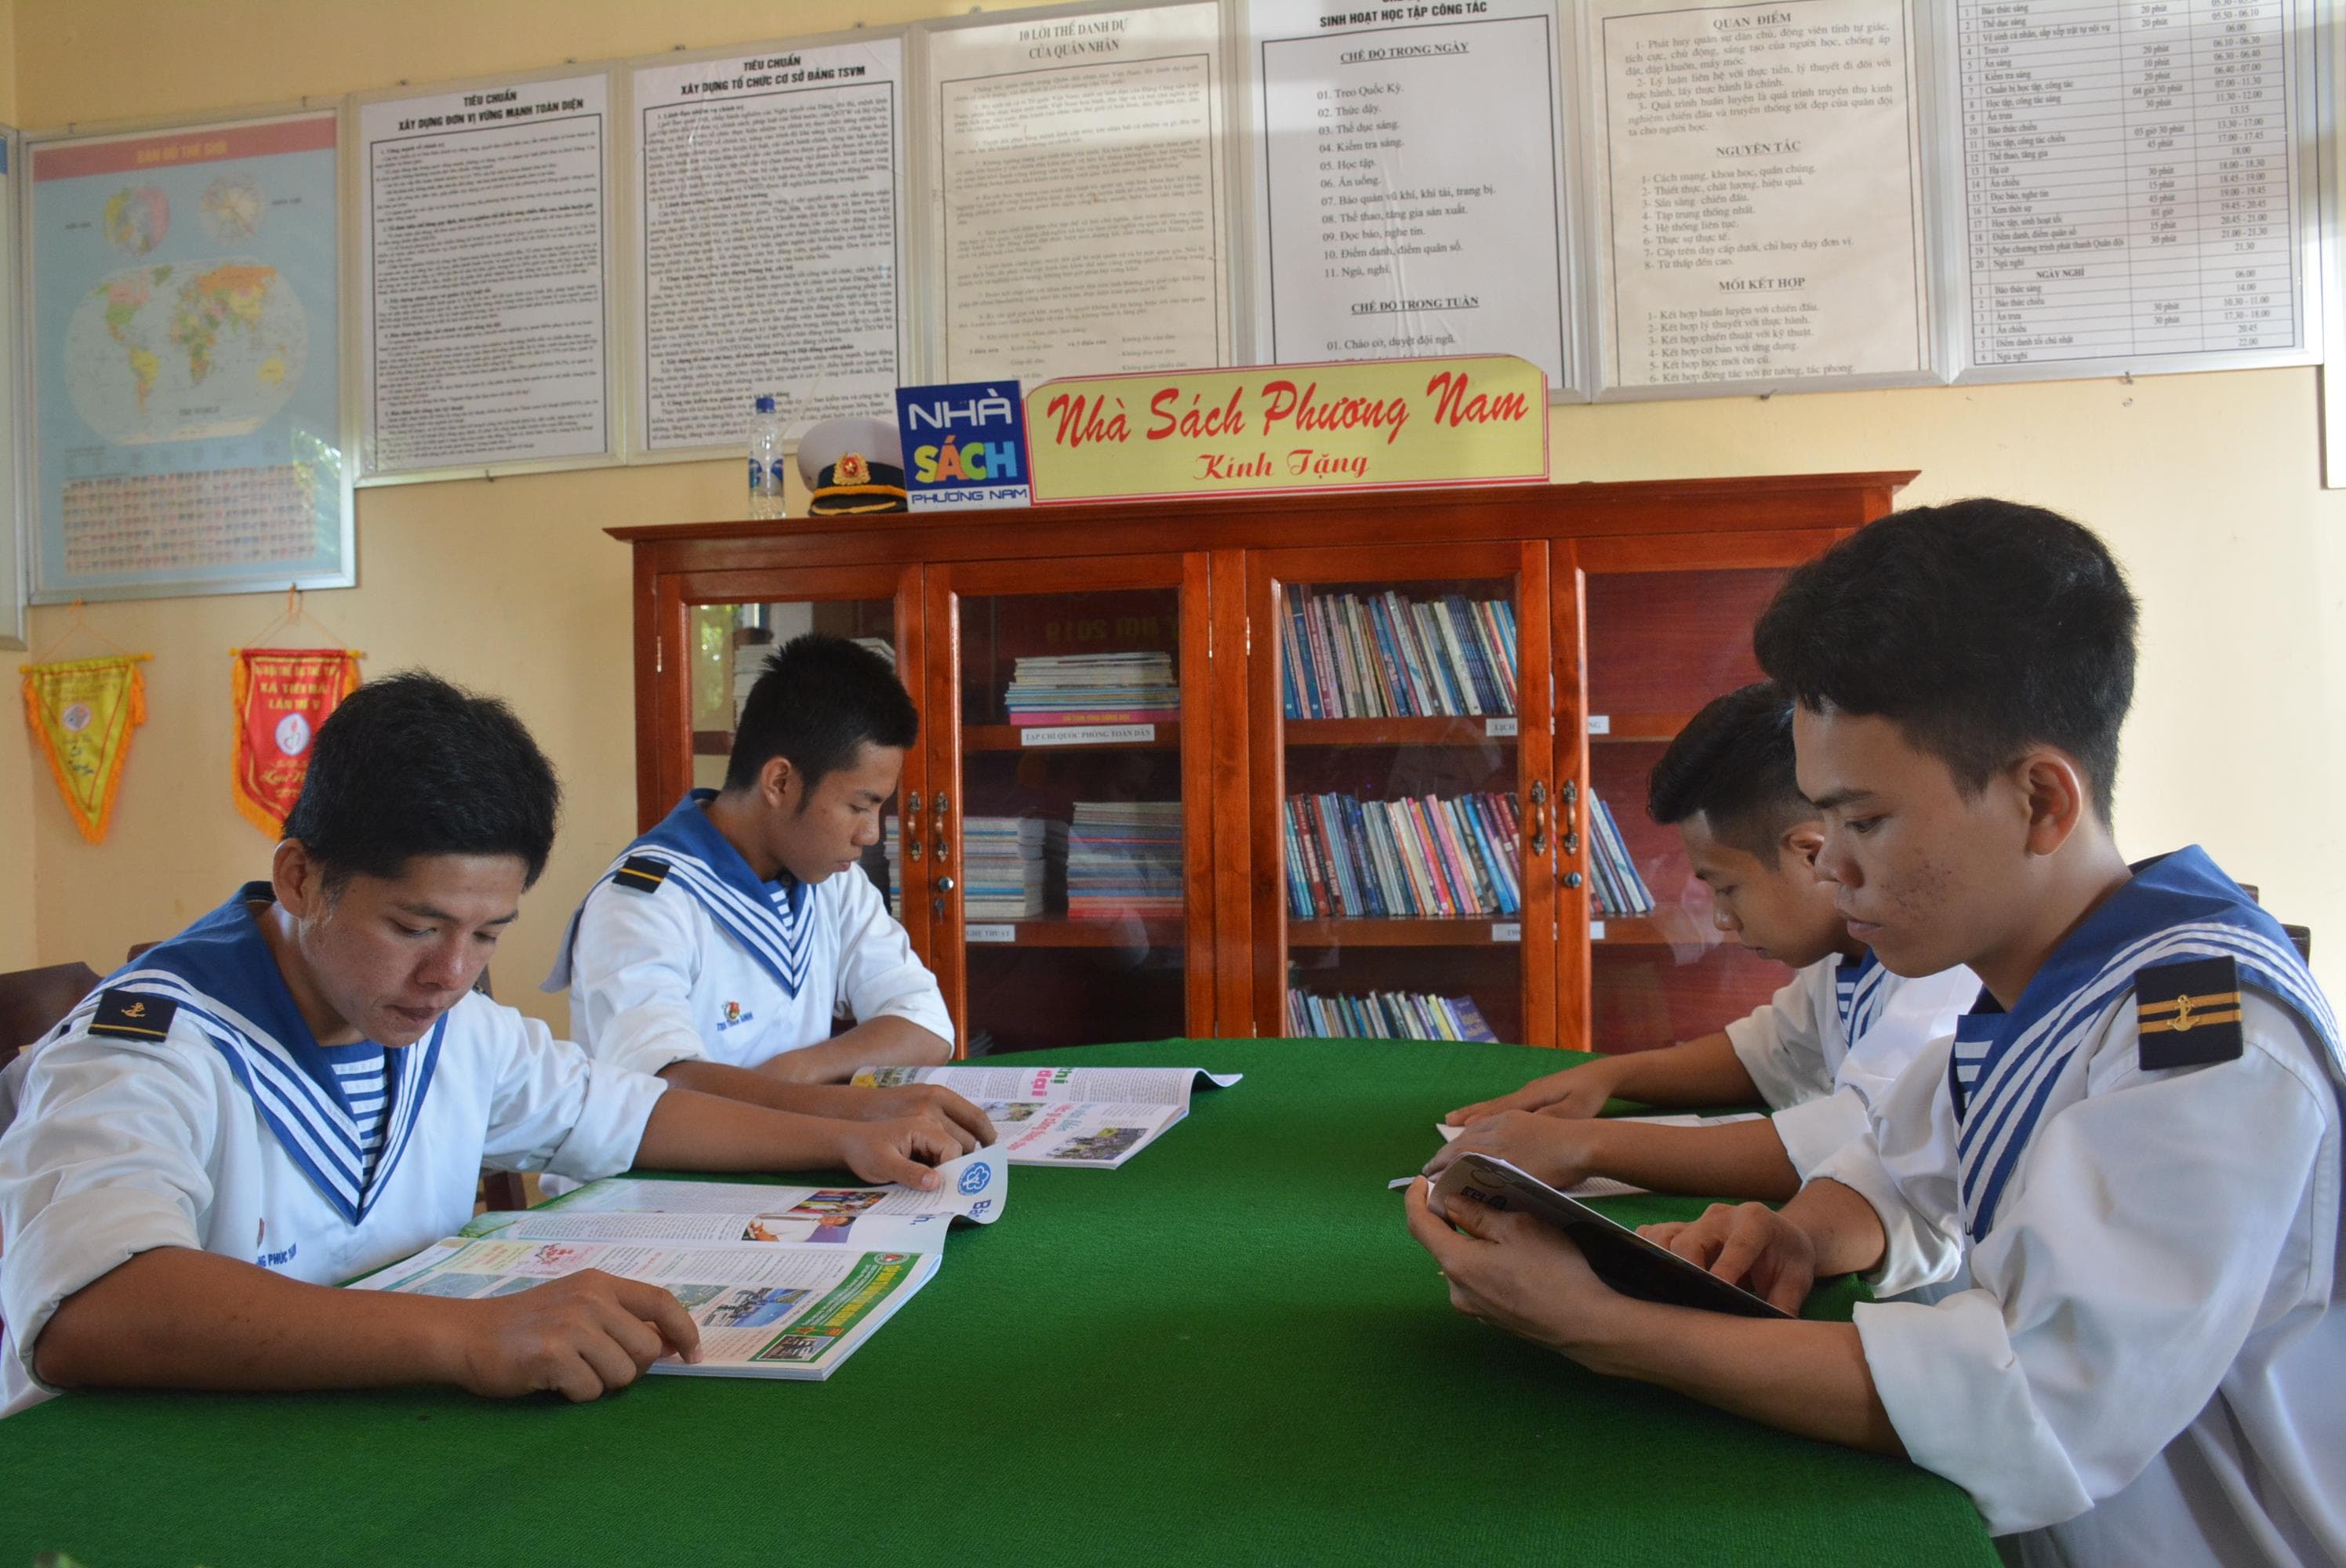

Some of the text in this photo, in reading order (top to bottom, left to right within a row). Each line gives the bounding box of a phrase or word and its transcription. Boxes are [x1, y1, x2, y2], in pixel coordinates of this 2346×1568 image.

[1320, 1, 1487, 27] SINH HOẠT HỌC TẬP CÔNG TÁC
[1713, 10, 1791, 30] QUAN ĐIỂM
[1019, 18, 1129, 41] 10 LỜI THỀ DANH DỰ
[1030, 38, 1120, 60] CỦA QUÂN NHÂN
[1389, 45, 1431, 58] TRONG
[1435, 42, 1469, 55] NGÀY
[743, 53, 801, 71] TIÊU CHUẨN
[681, 66, 865, 96] XÂY DỰNG TỔ CHỨC CƠ SỞ ĐẢNG TSVM
[463, 89, 517, 107] TIÊU CHUẨN
[1317, 82, 1404, 100] 01. Treo Quốc Kỳ.
[399, 98, 583, 131] XÂY DỰNG ĐƠN VỊ VỮNG MẠNH TOÀN DIỆN
[1318, 103, 1382, 118] 02. Thức dậy.
[1319, 120, 1400, 136] 03. Thể dục sáng.
[1320, 137, 1404, 154] 04. Kiểm tra sáng.
[1716, 139, 1800, 157] NGUYÊN TẮC
[1320, 156, 1375, 172] 05. Học tập.
[1323, 227, 1425, 242] 09. Đọc báo, nghe tin.
[1324, 241, 1463, 260] 10. Điểm danh, điểm quân số.
[1719, 276, 1805, 292] MỐI KẾT HỢP
[1400, 298, 1443, 310] TRONG
[910, 388, 1011, 430] NHÀ
[1047, 372, 1530, 448] Nhà Sách Phương Nam
[914, 434, 1017, 483] SÁCH
[1193, 450, 1371, 479] Kính Tặng
[911, 485, 1026, 505] PHƯƠNG NAM
